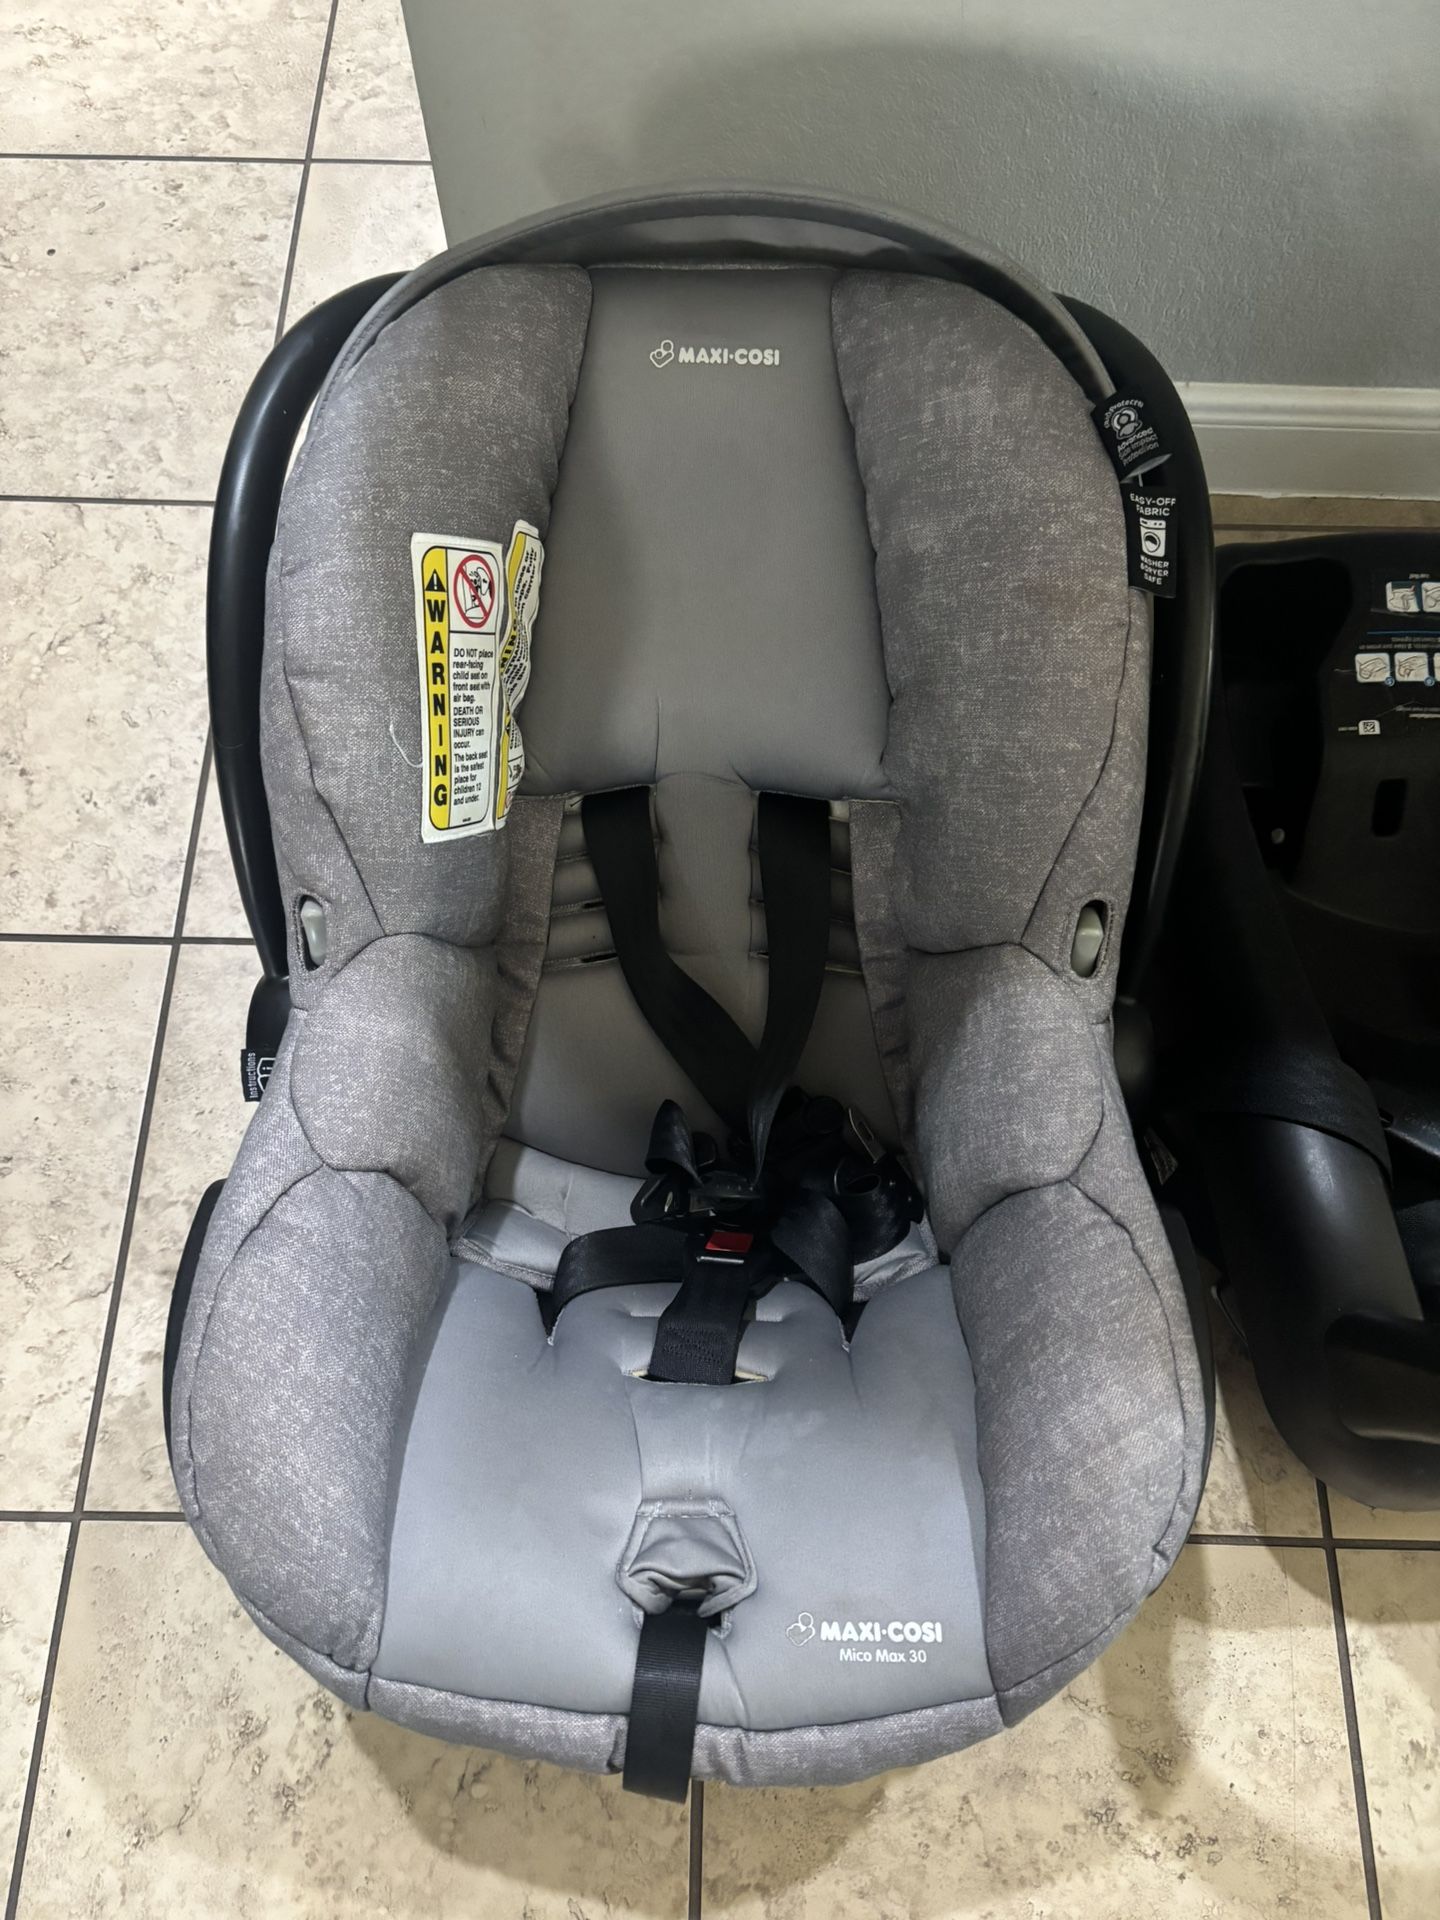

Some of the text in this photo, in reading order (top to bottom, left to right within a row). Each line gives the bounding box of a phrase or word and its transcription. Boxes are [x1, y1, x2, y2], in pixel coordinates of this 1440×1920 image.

[1130, 493, 1176, 506] EASY-OFF
[1136, 504, 1170, 516] FABRIC
[1144, 572, 1162, 585] SAFE
[453, 648, 493, 659] DO NOT place
[452, 660, 484, 671] rear-facing
[453, 671, 468, 680] child
[453, 682, 468, 691] front
[427, 599, 447, 806] WARNING
[453, 693, 462, 702] air
[453, 706, 483, 716] DEATH OR
[453, 717, 480, 727] SERIOUS
[453, 728, 484, 738] INJURY can
[453, 741, 471, 749] occur.
[454, 753, 465, 761] The
[466, 752, 478, 760] back
[461, 764, 469, 772] the
[470, 762, 484, 771] safest
[454, 776, 469, 785] place
[454, 782, 482, 795] children 12
[453, 796, 464, 806] and
[246, 1052, 259, 1098] Instructions
[839, 1648, 927, 1663] Mico Max 30
